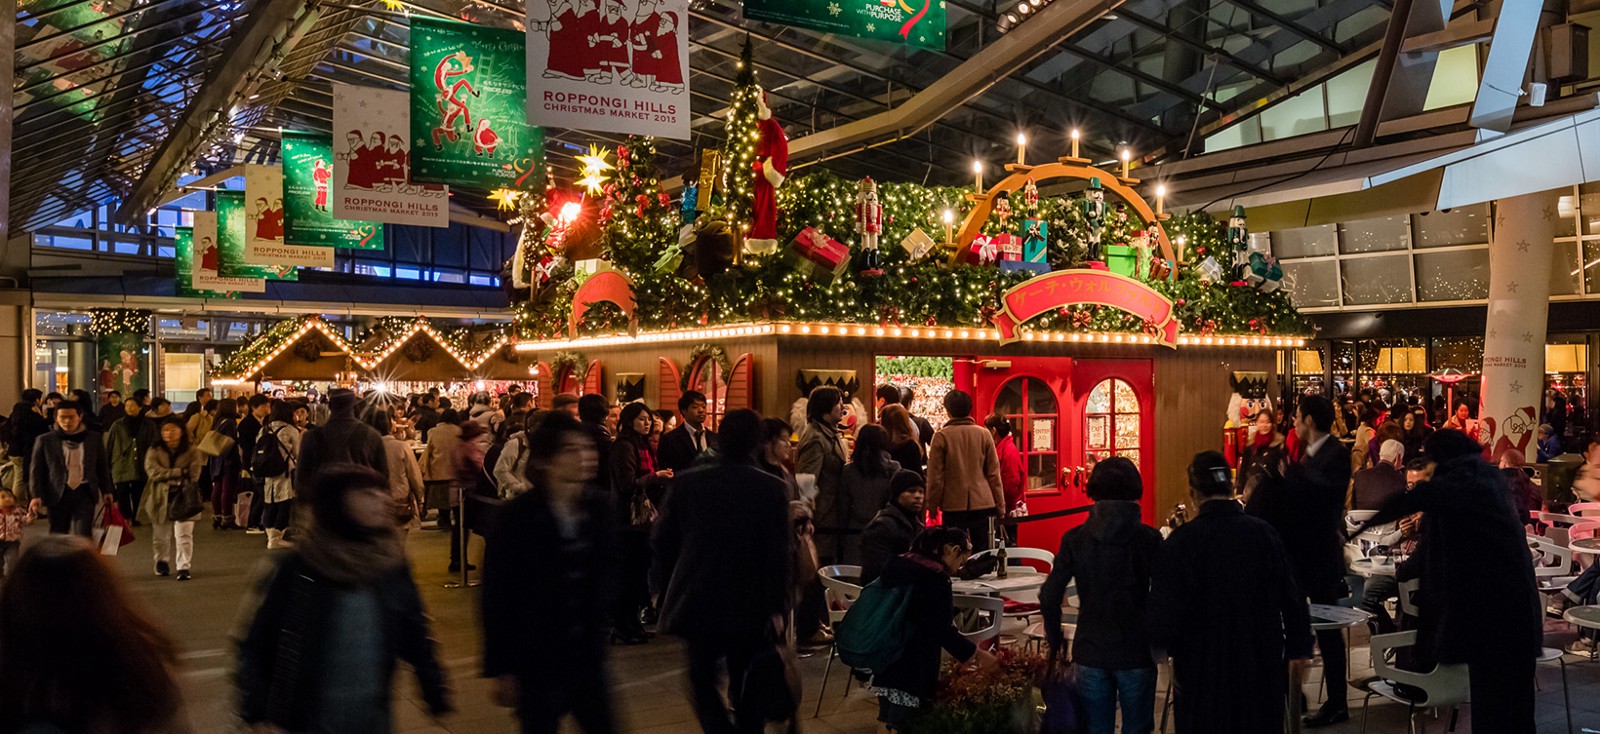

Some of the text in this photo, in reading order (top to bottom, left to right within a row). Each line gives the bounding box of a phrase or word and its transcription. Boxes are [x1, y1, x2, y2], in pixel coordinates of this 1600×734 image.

[865, 3, 902, 15] PURCHASE
[870, 9, 903, 22] PURPOSE
[543, 91, 677, 115] ROPPONGI HILLS
[543, 103, 677, 124] CHRISTMAS MARKET 2015
[344, 197, 439, 212] ROPPONGI HILLS
[344, 205, 388, 213] CHRISTMAS
[390, 208, 419, 216] MARKET
[253, 247, 299, 255] ROPPONGI
